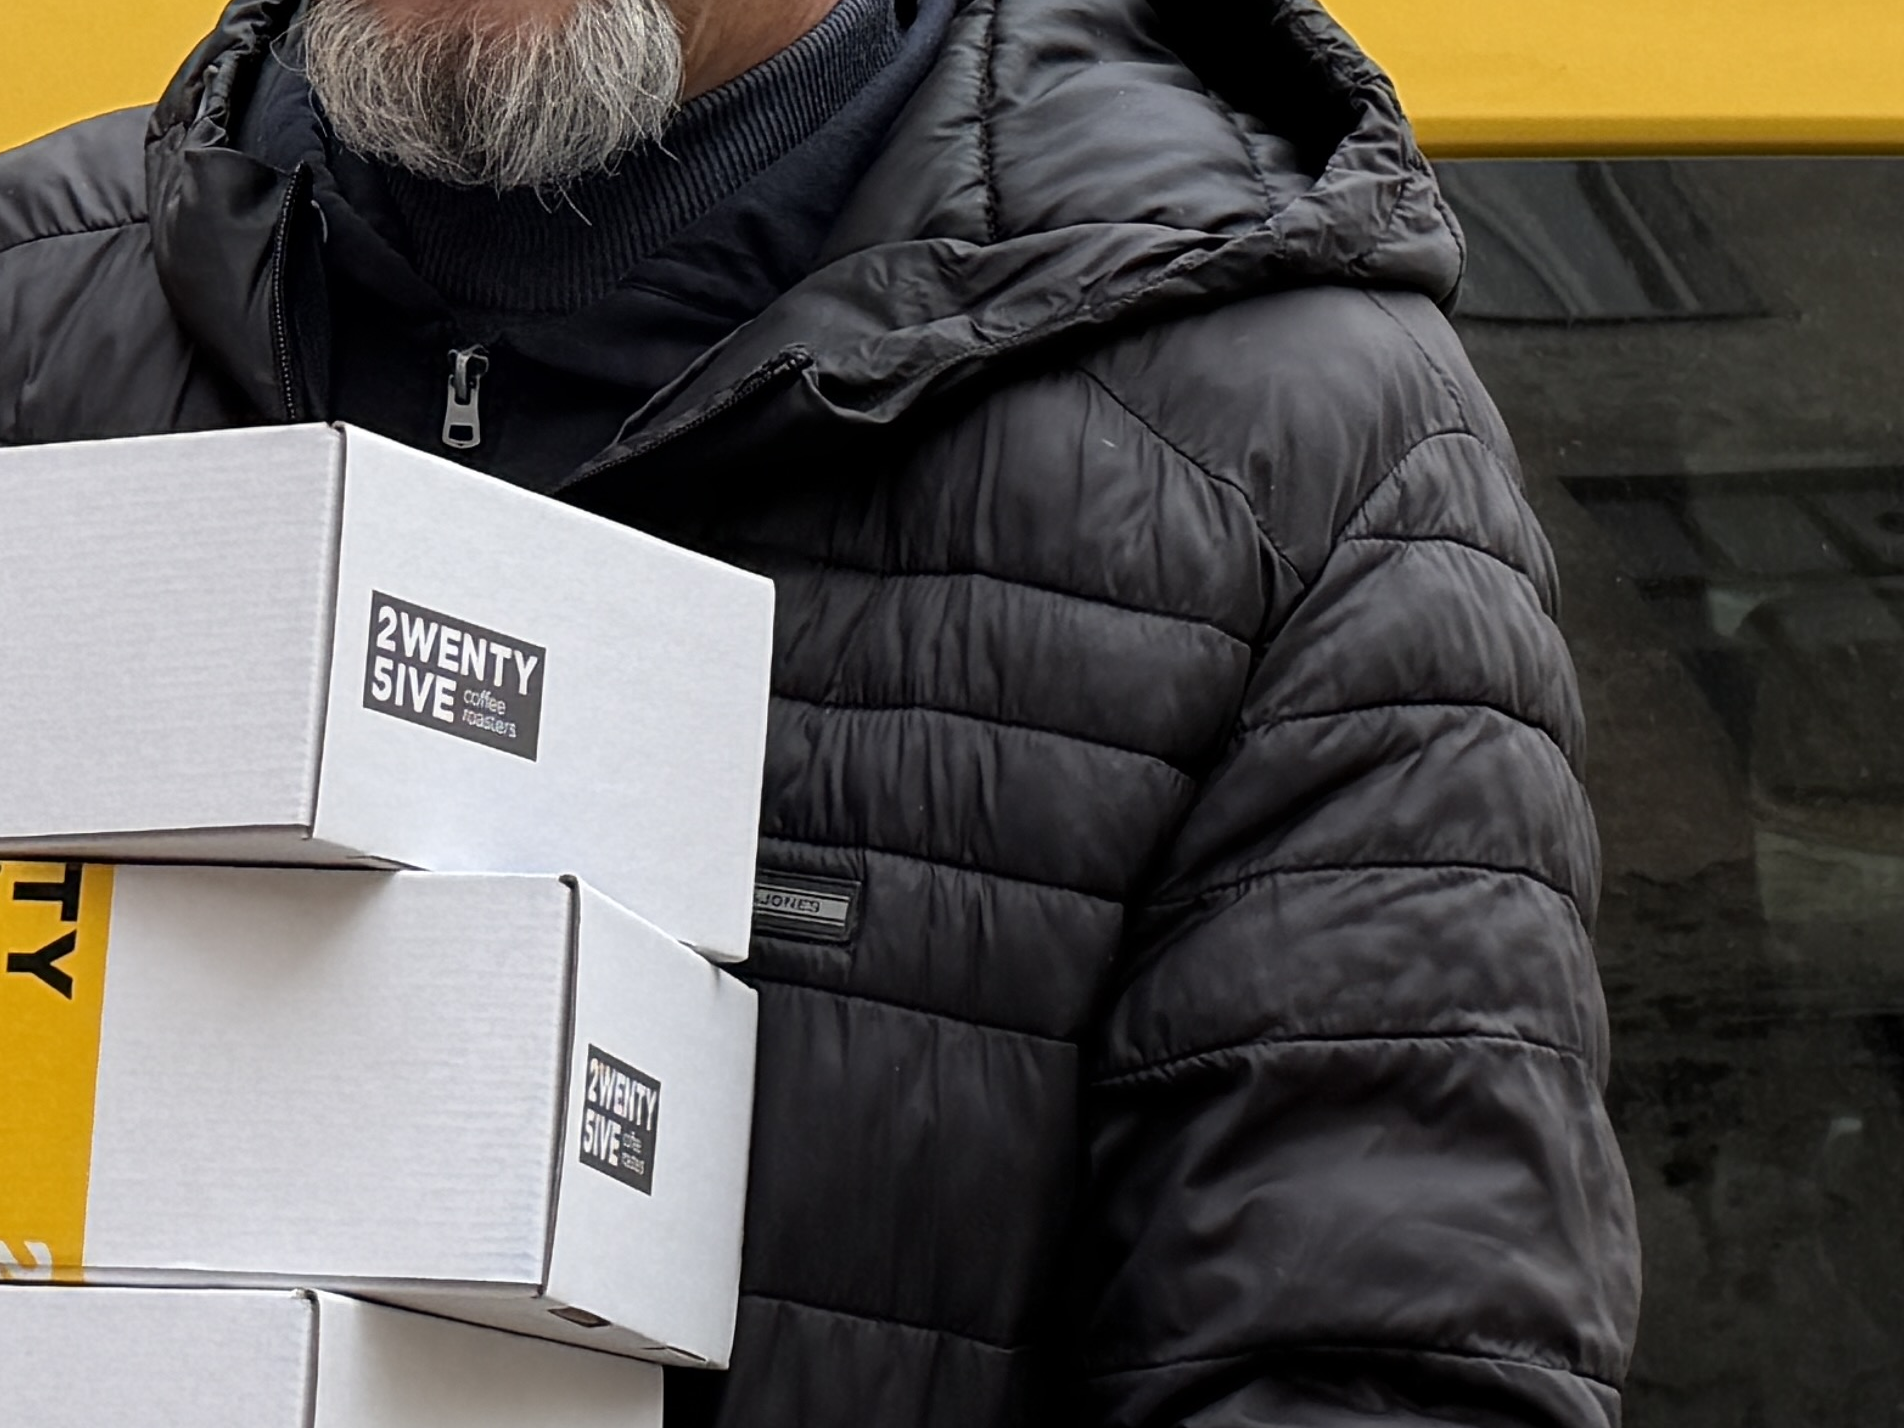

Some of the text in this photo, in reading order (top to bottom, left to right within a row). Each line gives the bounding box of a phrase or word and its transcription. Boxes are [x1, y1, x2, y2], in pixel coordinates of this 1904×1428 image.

[376, 605, 538, 696] 2WENTY
[371, 655, 457, 723] 5IVE
[463, 689, 507, 715] coffee
[462, 708, 517, 738] roasters
[587, 1057, 657, 1131] 2WENTY
[583, 1108, 622, 1167] 5IVE
